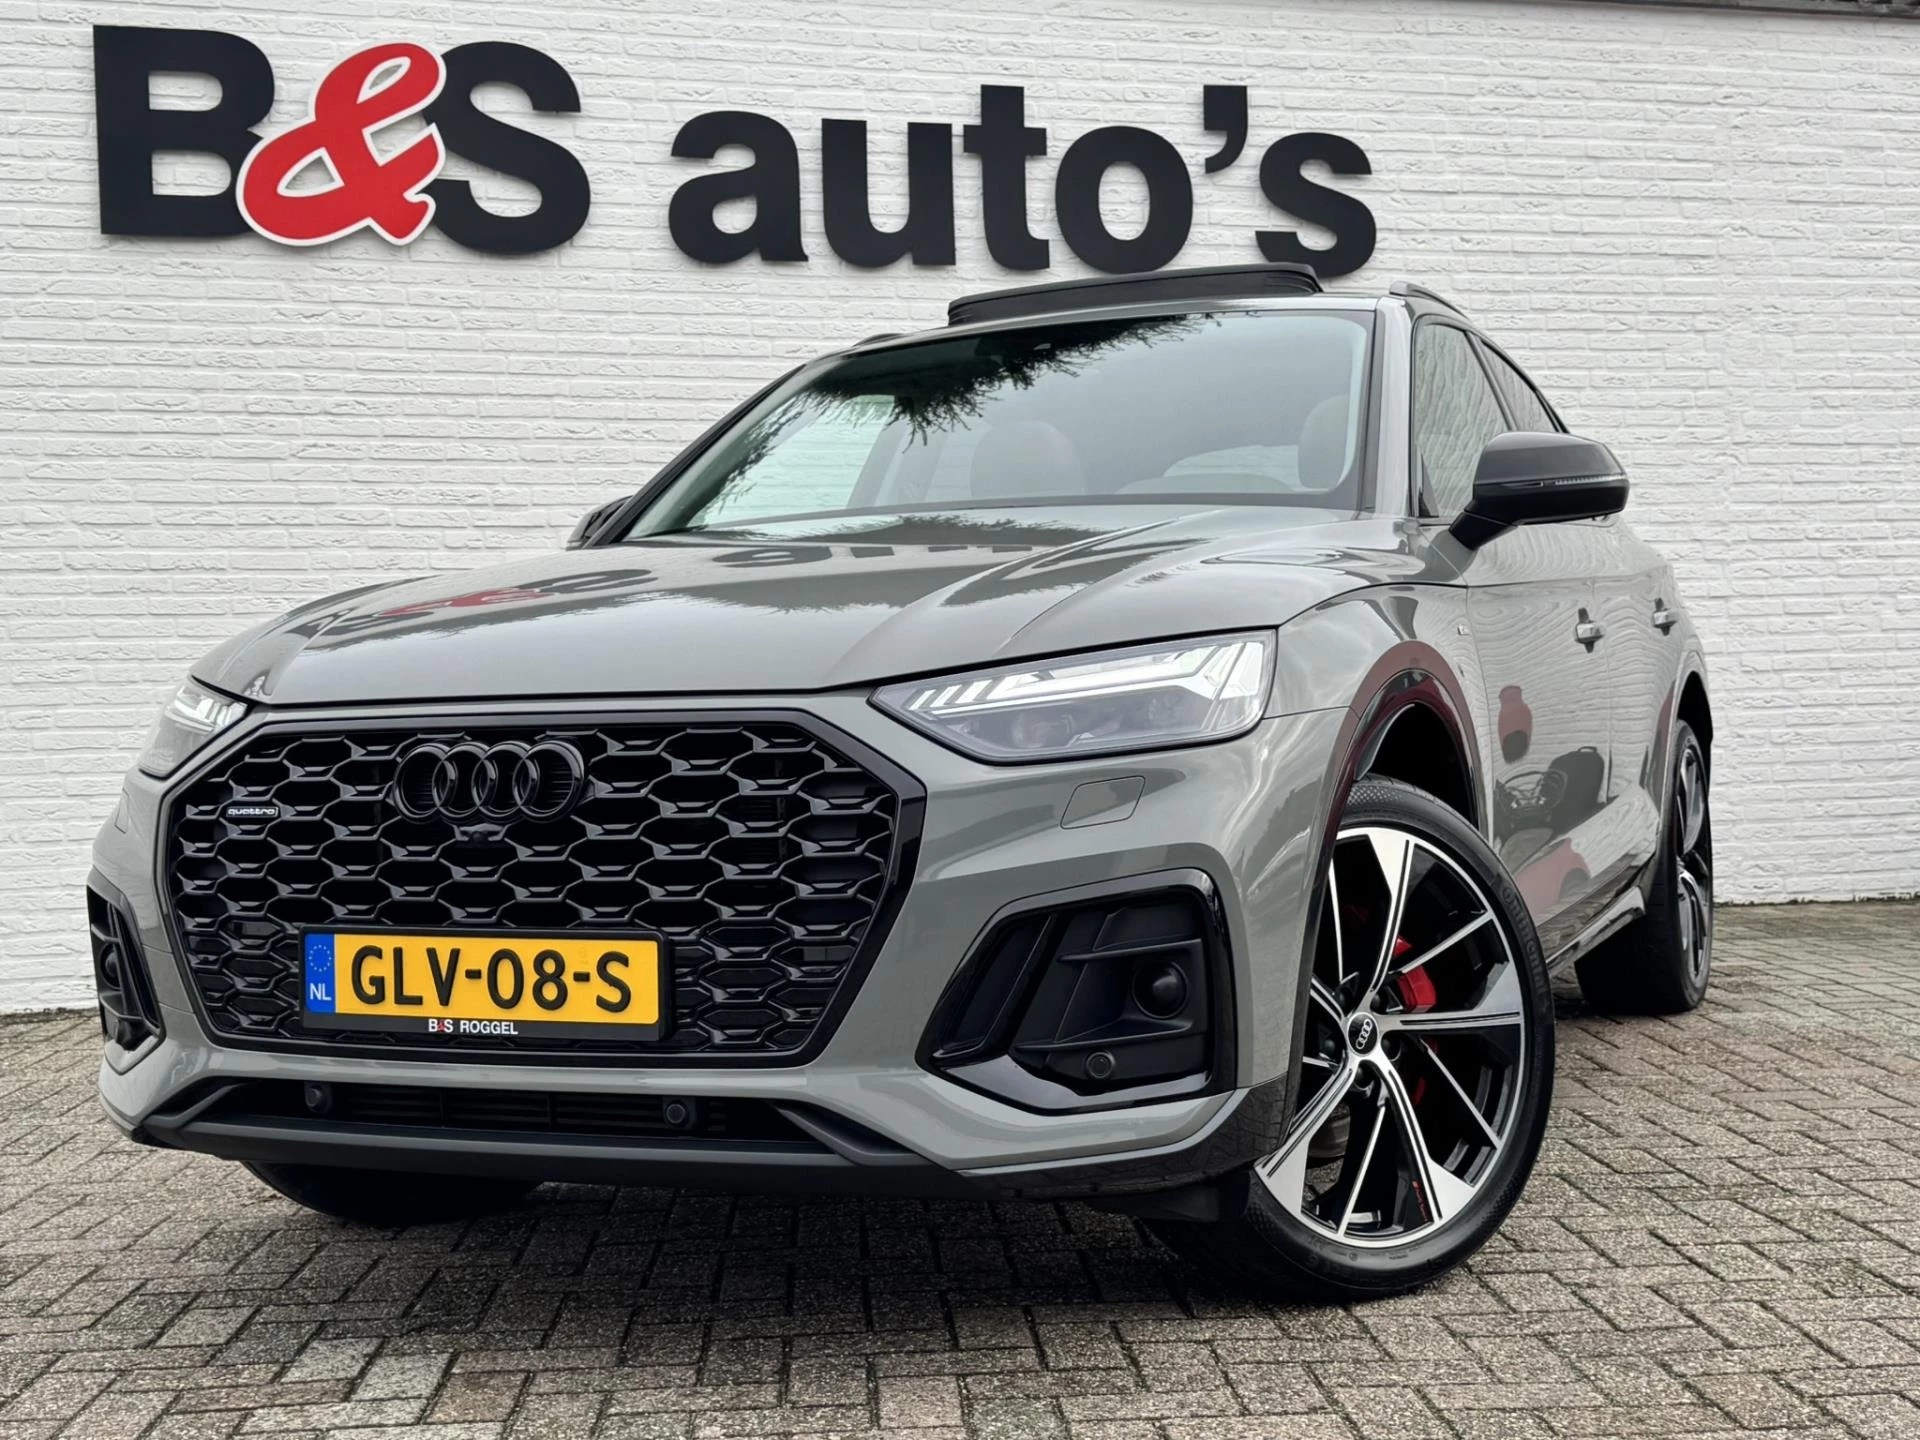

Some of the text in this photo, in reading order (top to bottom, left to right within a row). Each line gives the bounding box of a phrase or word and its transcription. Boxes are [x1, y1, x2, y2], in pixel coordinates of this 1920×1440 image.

[93, 24, 591, 255] B&S
[227, 807, 276, 816] quattro
[351, 944, 632, 1013] GLV-08-S
[309, 982, 332, 1001] NL
[428, 1018, 519, 1035] B&S ROGGEL
